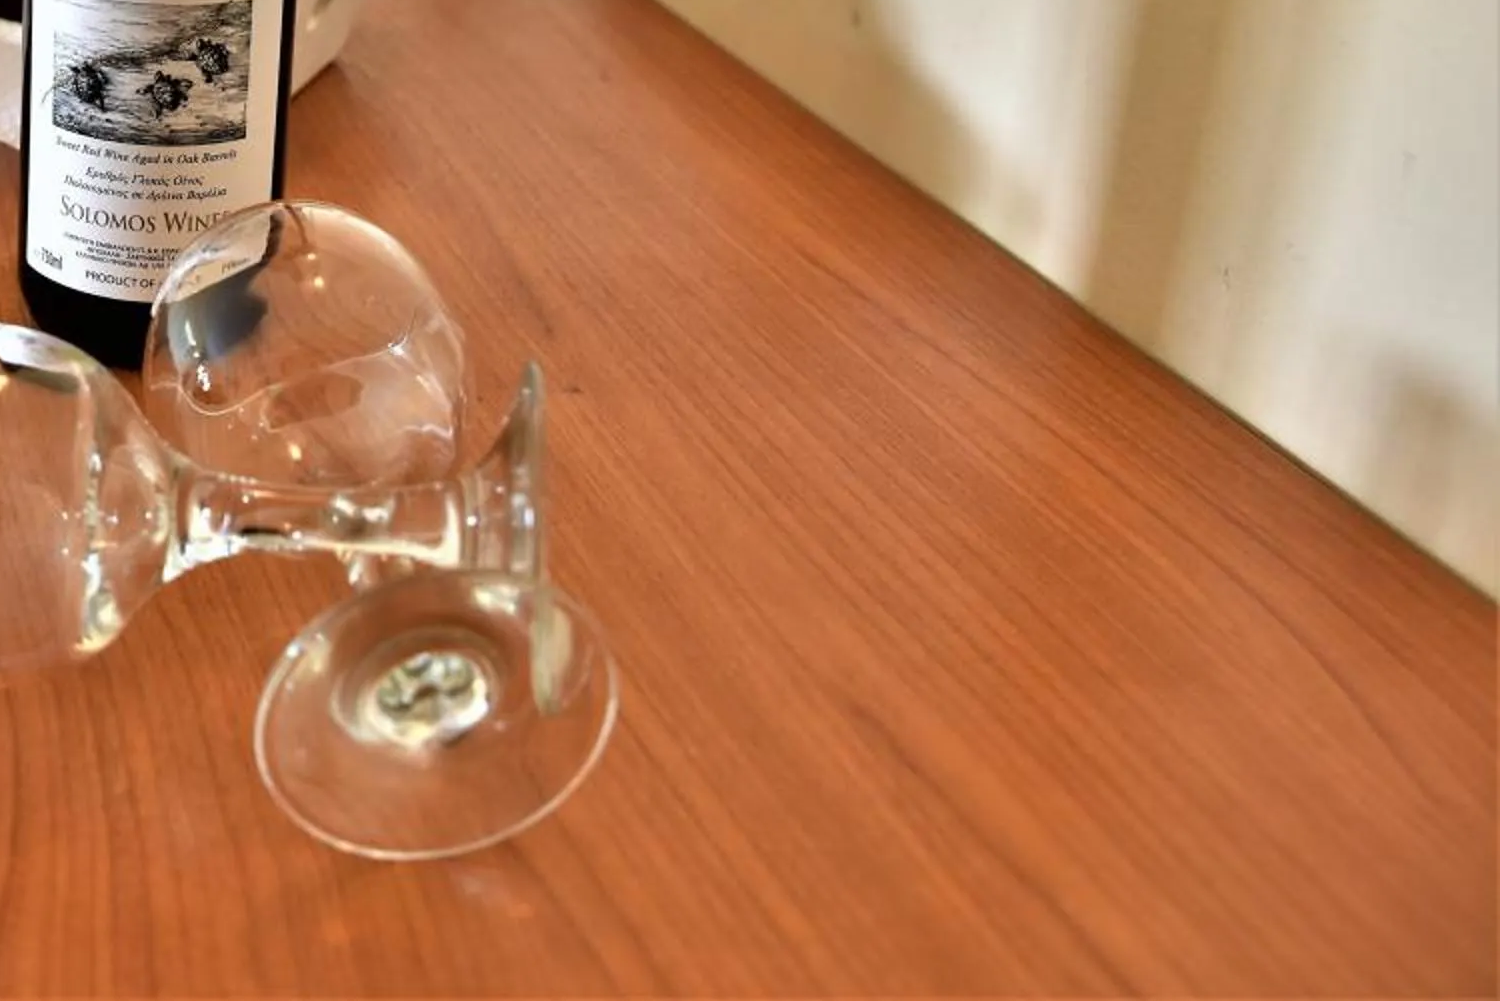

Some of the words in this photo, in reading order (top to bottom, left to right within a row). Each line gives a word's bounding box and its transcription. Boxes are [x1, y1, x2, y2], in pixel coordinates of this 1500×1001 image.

[56, 135, 81, 151] Sweet
[81, 144, 101, 157] Red
[103, 148, 129, 162] Wine
[131, 153, 161, 166] Aged
[163, 155, 173, 164] in
[176, 152, 199, 164] Oak
[201, 148, 238, 164] Barrels
[60, 194, 156, 234] SOLOMOS
[85, 270, 138, 288] PRODUCT
[139, 278, 157, 289] OF
